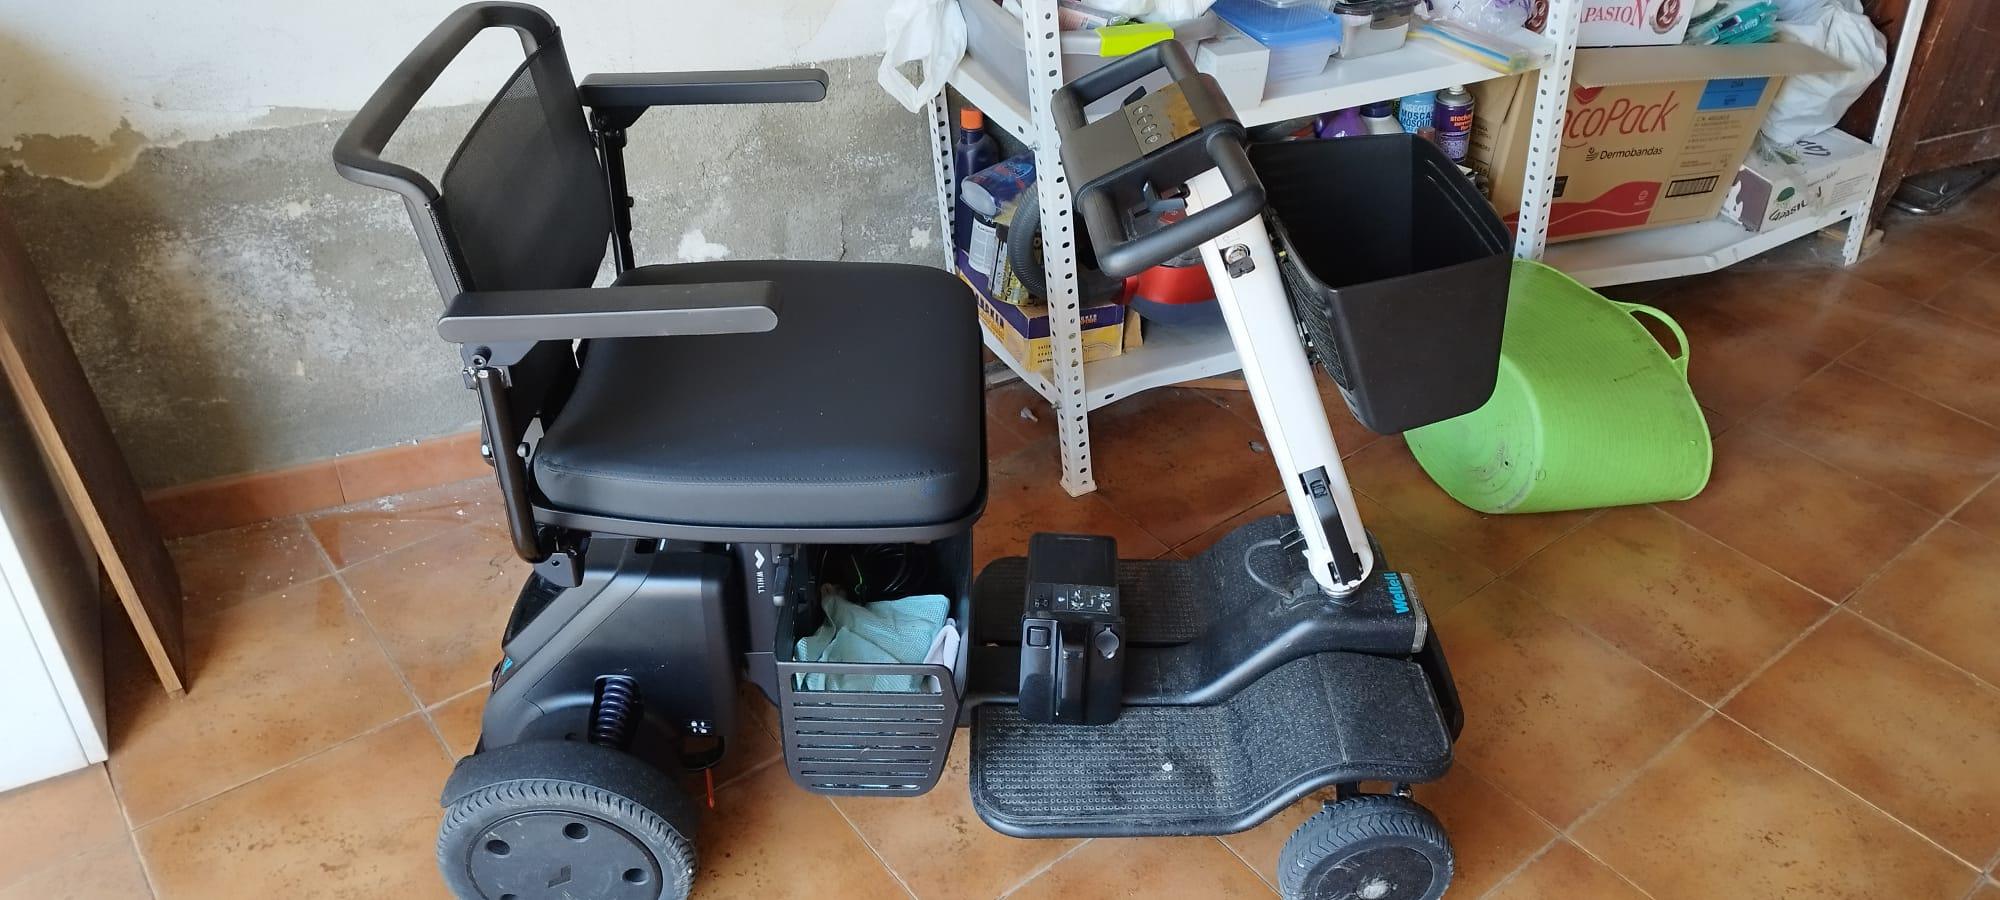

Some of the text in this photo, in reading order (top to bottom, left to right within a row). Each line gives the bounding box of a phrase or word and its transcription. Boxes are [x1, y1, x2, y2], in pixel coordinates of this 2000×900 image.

[1600, 146, 1664, 160] Dermobandas
[756, 571, 765, 594] WHILL
[1383, 572, 1410, 614] Wellell
